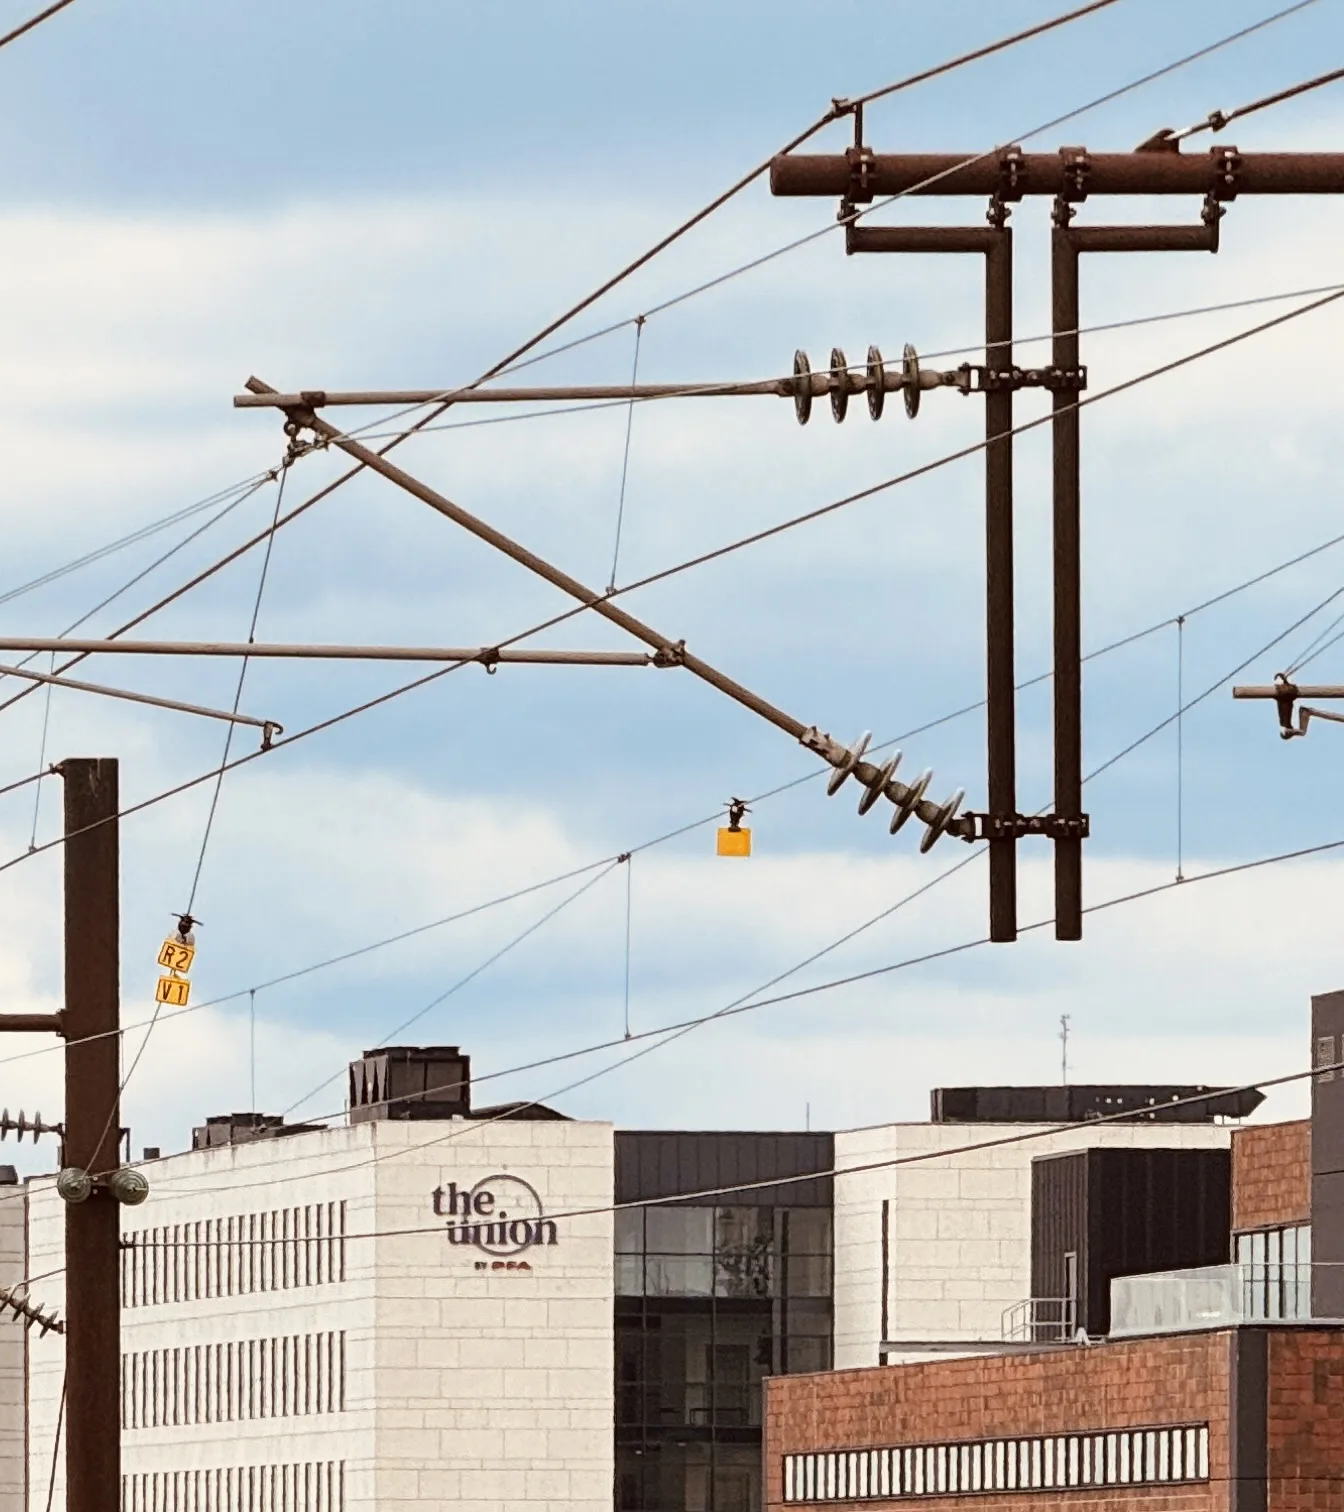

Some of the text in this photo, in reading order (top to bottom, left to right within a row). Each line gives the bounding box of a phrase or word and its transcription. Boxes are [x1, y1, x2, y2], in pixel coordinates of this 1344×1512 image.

[162, 945, 189, 969] R2
[162, 981, 184, 1003] V1
[432, 1182, 495, 1216] the
[446, 1211, 558, 1245] union
